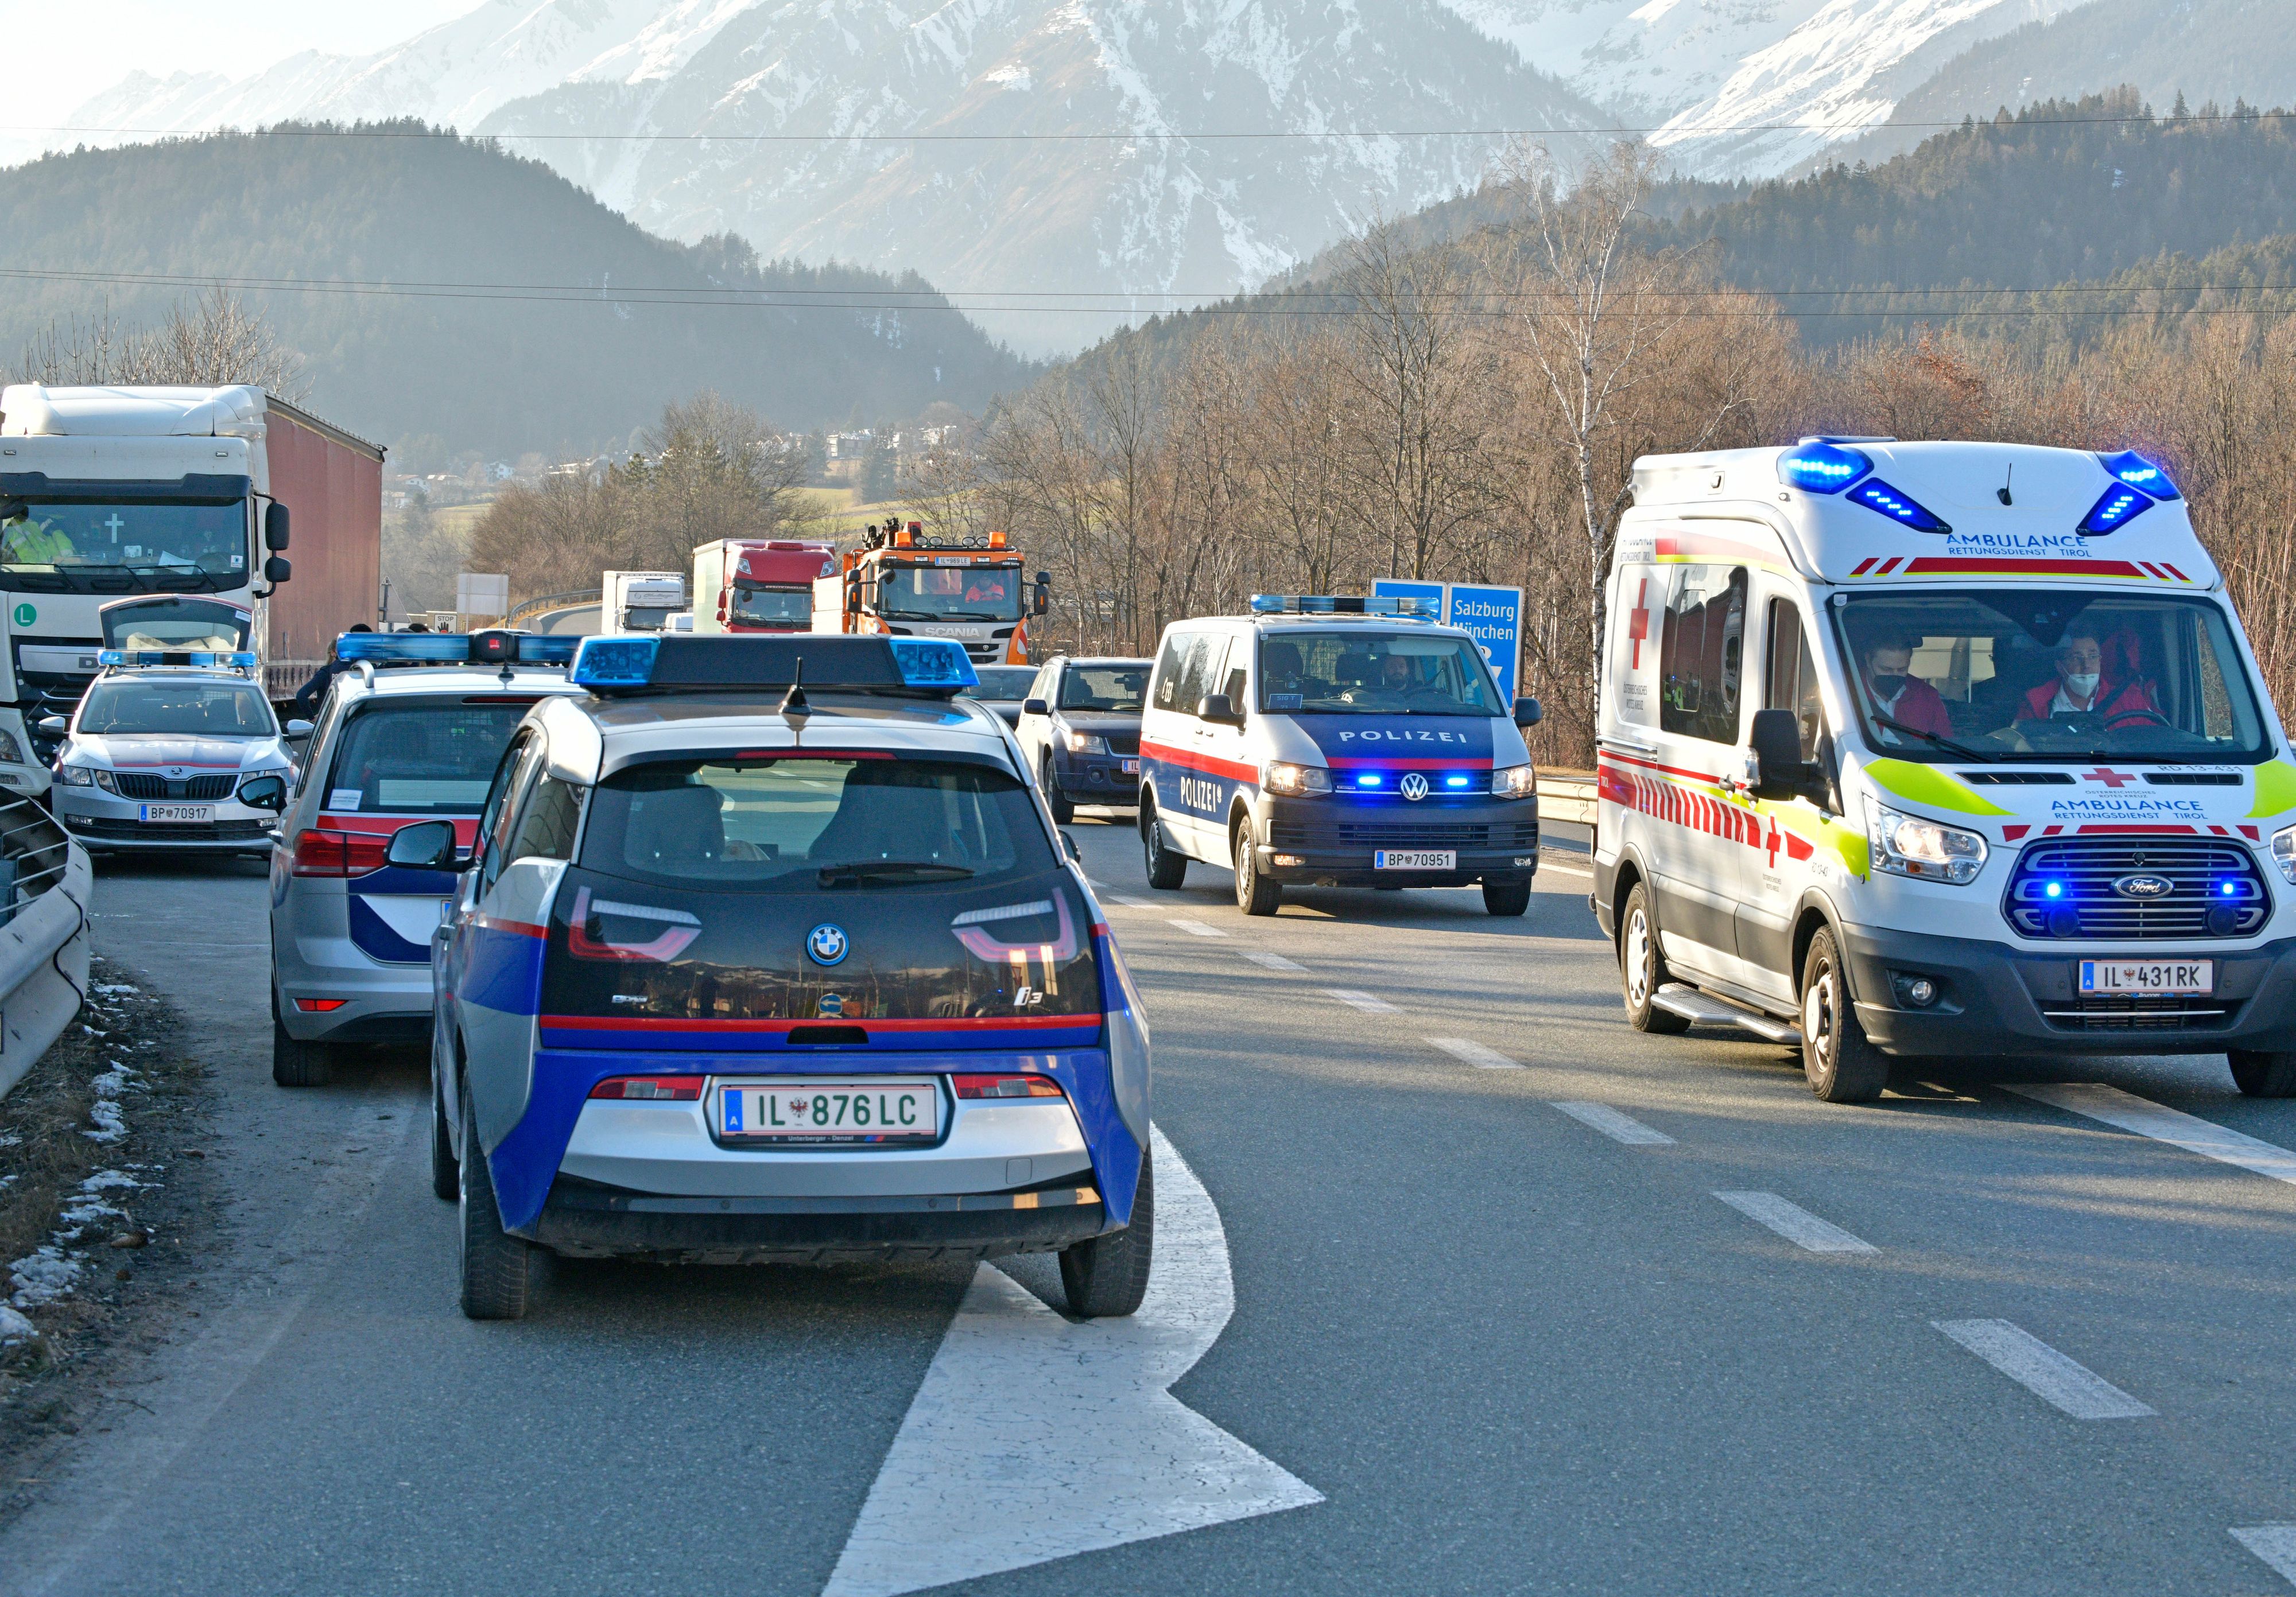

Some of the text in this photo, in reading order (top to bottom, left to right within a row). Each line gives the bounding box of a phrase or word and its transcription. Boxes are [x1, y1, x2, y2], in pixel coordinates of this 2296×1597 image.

[1946, 534, 2088, 547] AMBULANCE
[1949, 547, 2092, 557] RETTUNGSDIENST TIROL
[21, 607, 30, 623] L
[1455, 600, 1514, 621] Salzburg
[925, 628, 980, 637] SCANIA
[1453, 622, 1513, 640] München
[1164, 682, 1174, 704] 133
[1339, 730, 1467, 743] POLIZEI
[1131, 762, 1138, 770] IL
[1181, 776, 1216, 813] POLIZEI
[2051, 801, 2204, 811] AMBULANCE
[152, 808, 165, 818] BP
[174, 808, 207, 819] 70917
[1389, 854, 1403, 865] BP
[1414, 854, 1449, 866] 70951
[2129, 879, 2161, 893] Ford
[815, 927, 842, 939] BMW
[2105, 967, 2121, 987] IL
[2138, 966, 2171, 987] 431
[2177, 966, 2200, 986] RK
[730, 1094, 916, 1125] A IL 876 LC
